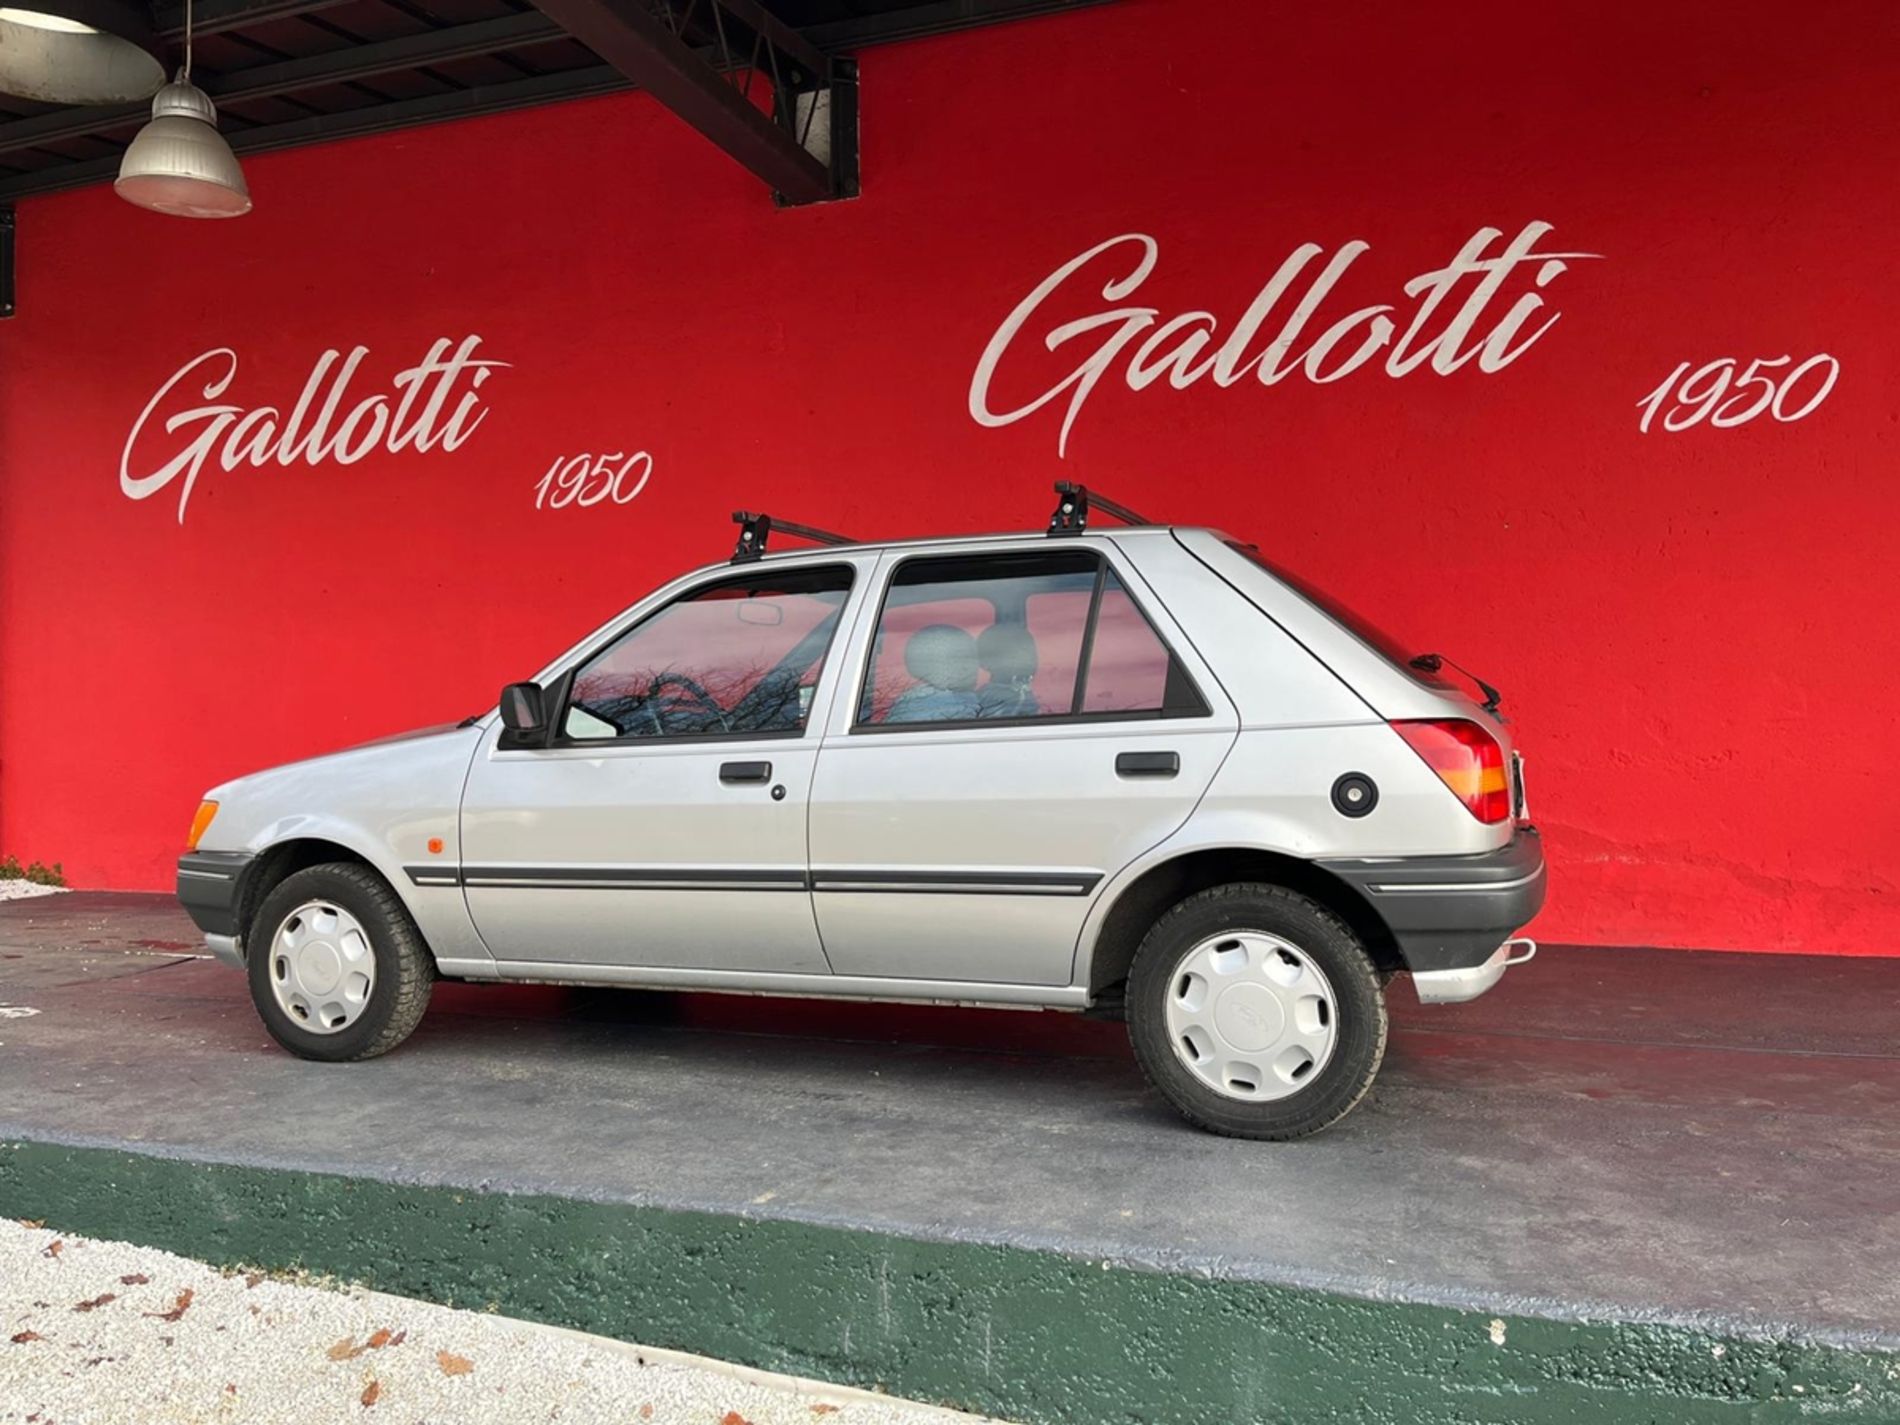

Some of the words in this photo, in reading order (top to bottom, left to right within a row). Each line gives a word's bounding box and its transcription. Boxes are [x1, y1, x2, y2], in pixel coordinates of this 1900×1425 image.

[968, 219, 1603, 458] Gallotti
[1636, 352, 1841, 434] 1950
[119, 334, 514, 525] Gallotti
[535, 450, 654, 510] 1950
